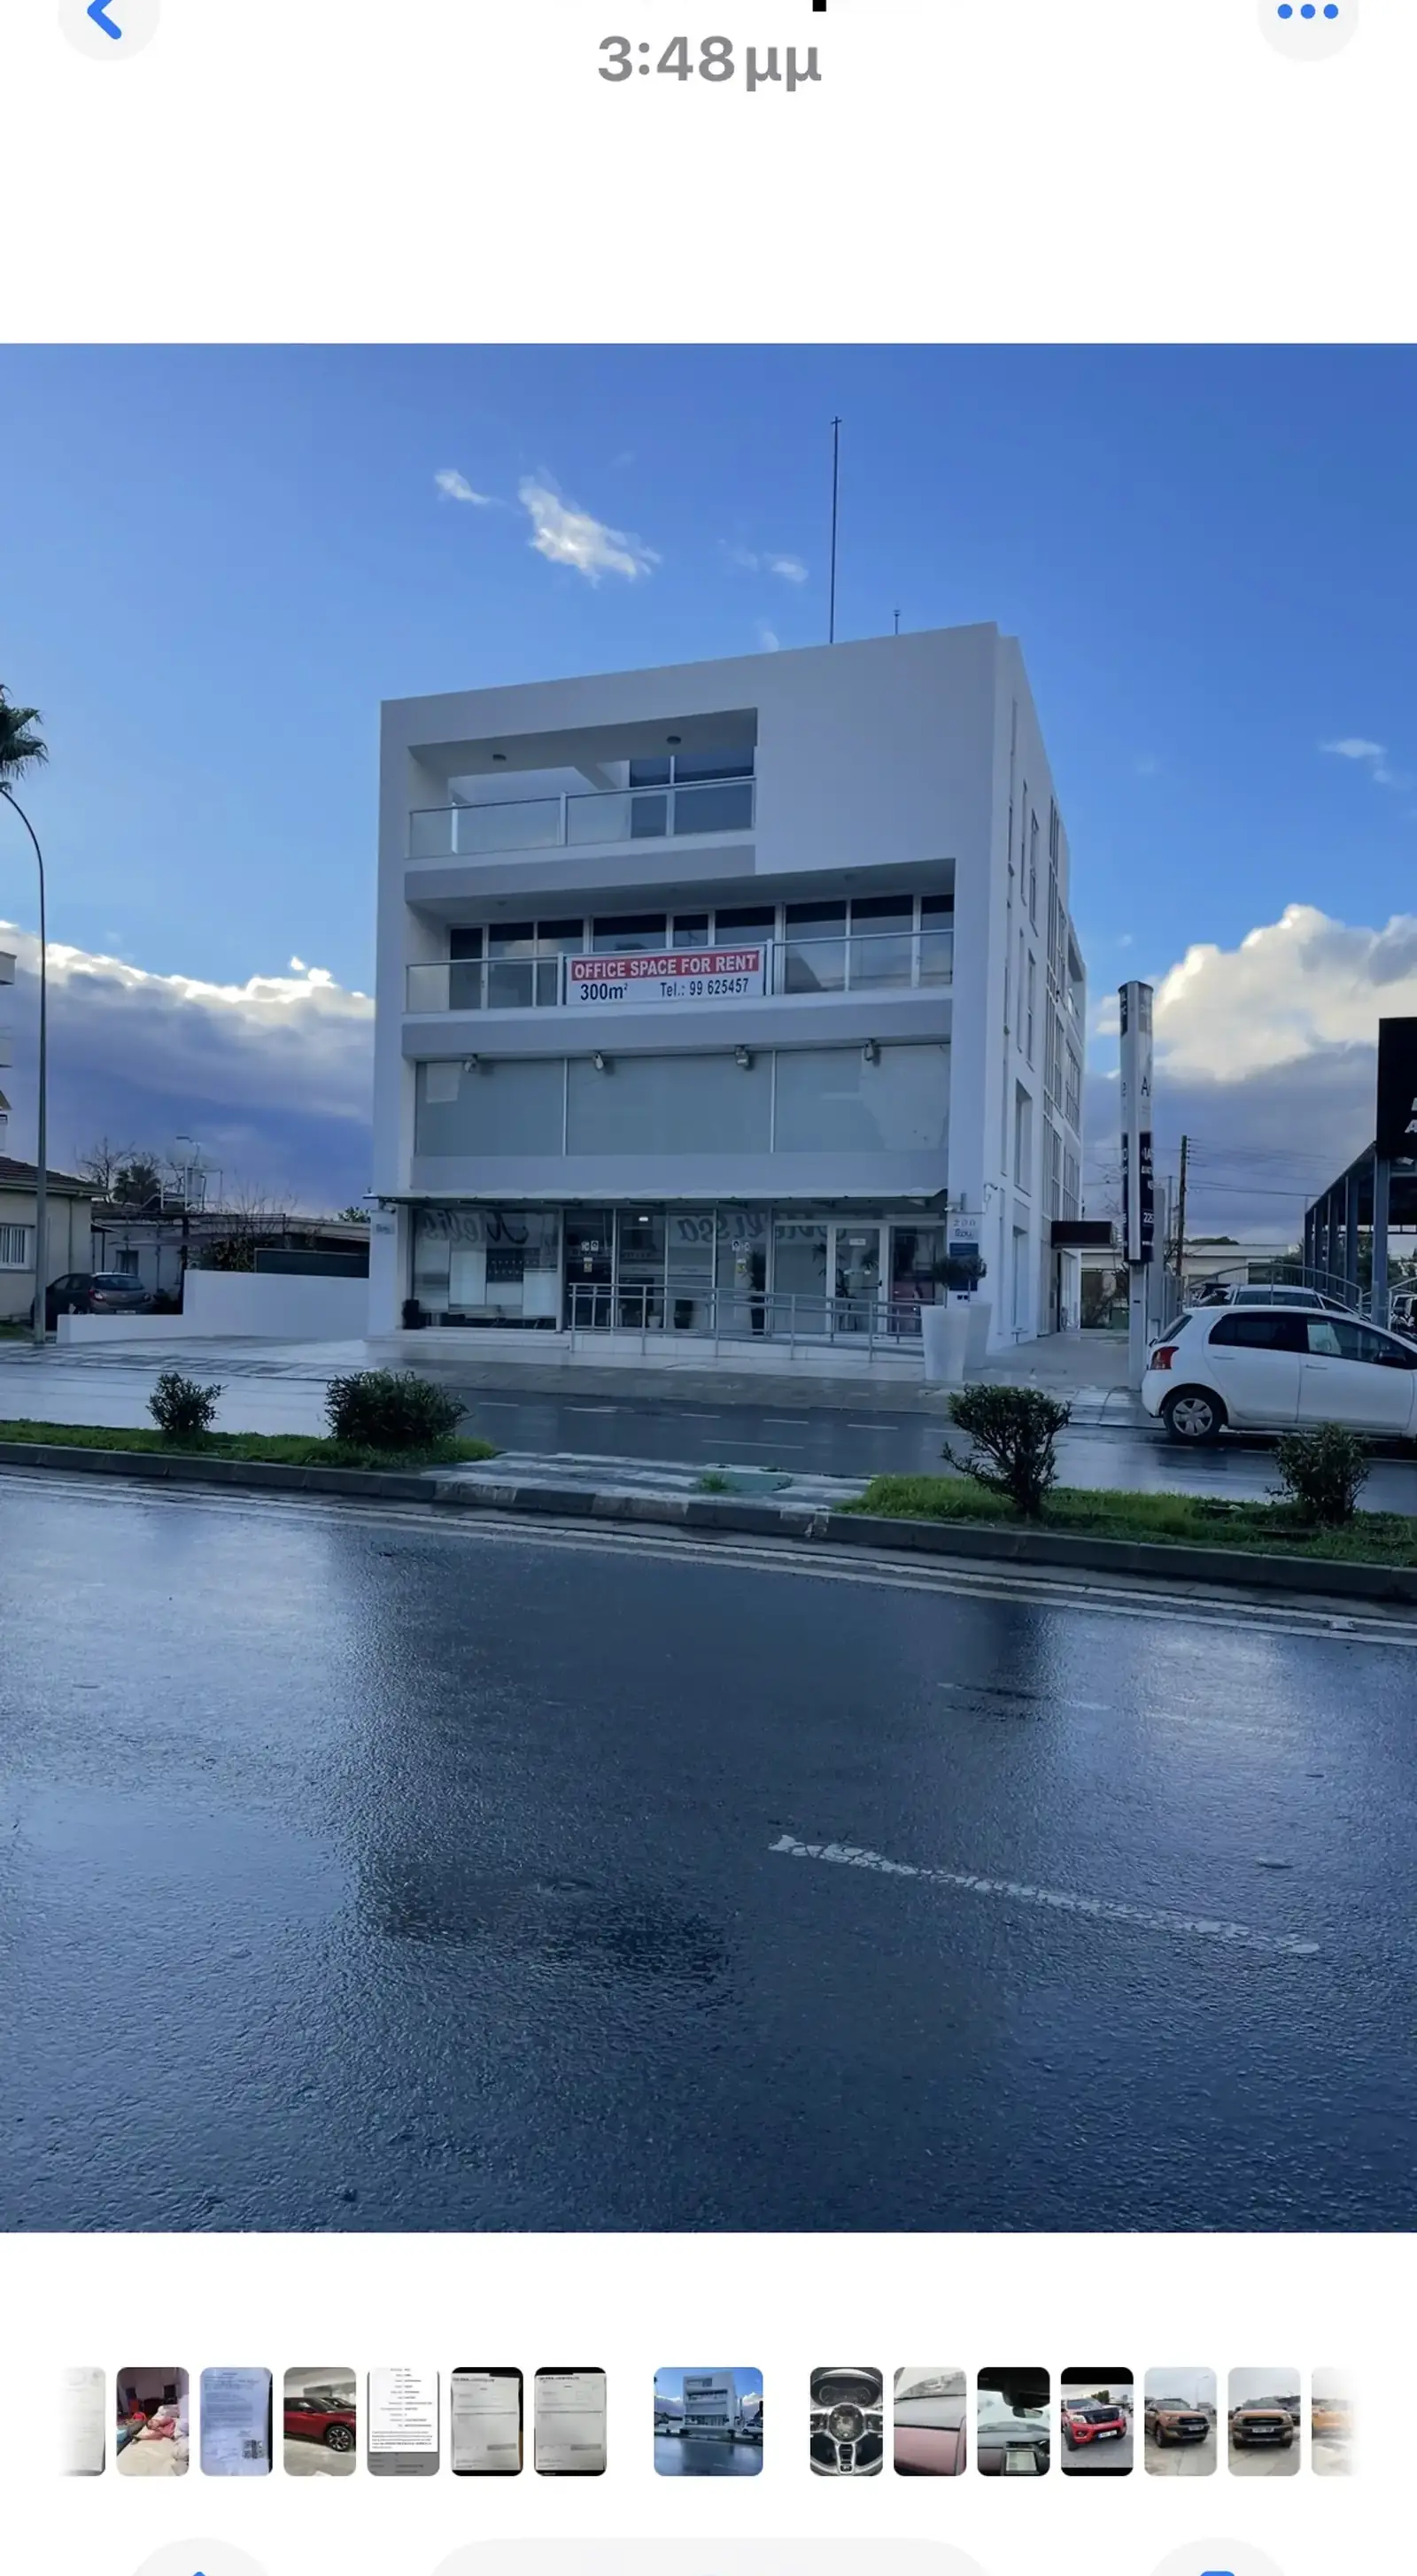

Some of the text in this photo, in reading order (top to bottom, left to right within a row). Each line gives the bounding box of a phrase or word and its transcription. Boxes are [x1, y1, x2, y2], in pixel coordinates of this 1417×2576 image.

[599, 35, 822, 92] 3:48 μμ
[575, 954, 756, 979] OFFICE SPACE FOR RENT
[661, 978, 749, 997] Tel.: 99 625457
